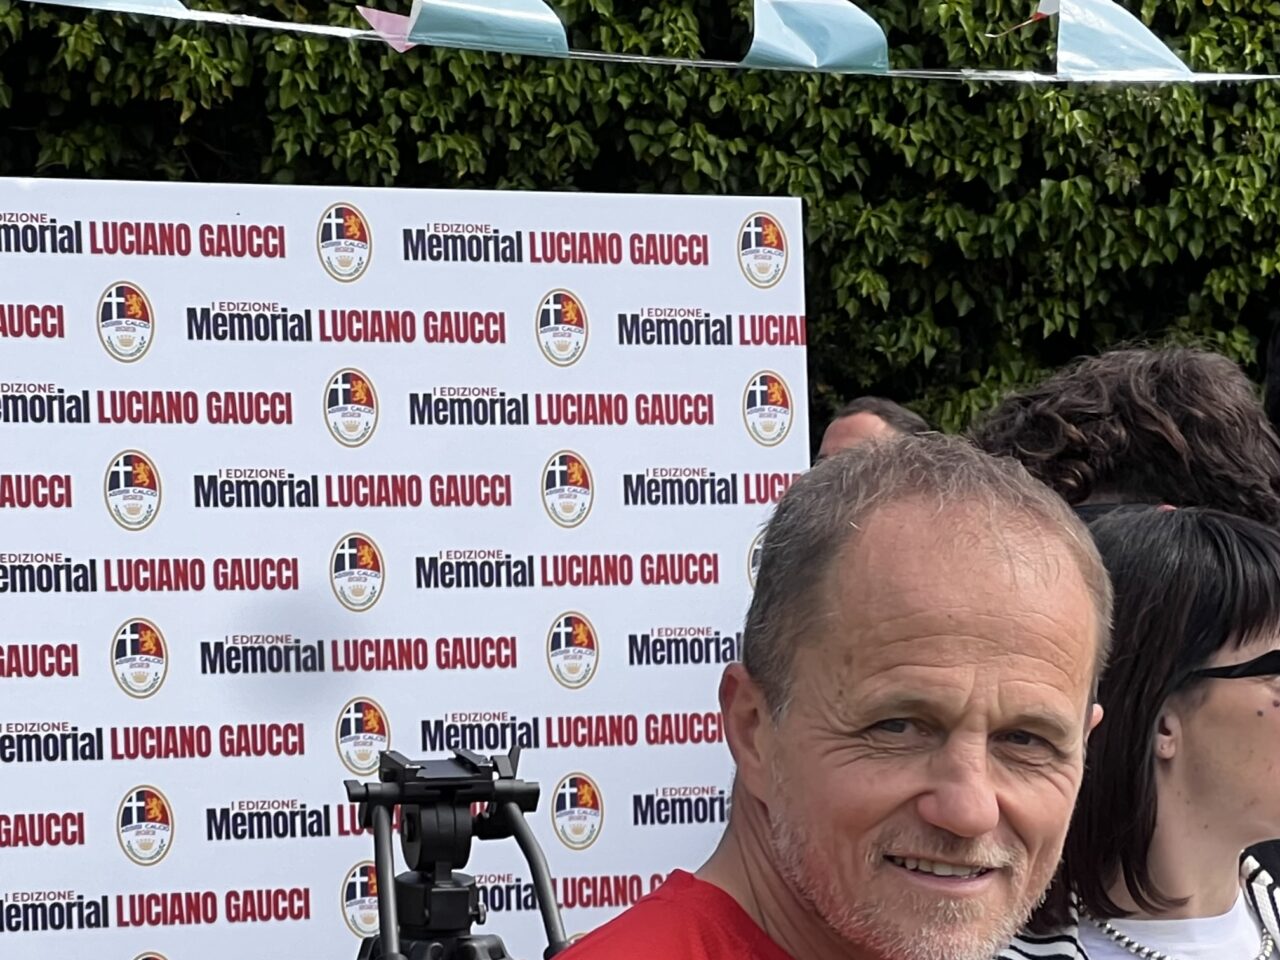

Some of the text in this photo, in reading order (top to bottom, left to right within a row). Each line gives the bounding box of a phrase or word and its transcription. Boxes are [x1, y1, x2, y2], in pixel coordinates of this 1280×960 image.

[0, 213, 47, 223] IZIONE
[434, 223, 491, 234] EDIZIONE
[0, 218, 286, 258] morial LUCIANO GAUCCI
[403, 228, 710, 265] Memorial LUCIANO GAUCCI
[0, 304, 64, 337] AUCCI
[219, 302, 279, 313] EDIZIONE
[648, 308, 702, 318] EDIZIONE
[187, 307, 506, 344] Memorial LUCIANO GAUCCI
[618, 313, 807, 346] Memorial LUCIA
[0, 383, 55, 393] DIZIONE
[440, 387, 498, 397] EDIZIONE
[0, 388, 293, 424] morial LUCIANO GAUCCI
[410, 393, 715, 426] Memorial LUCIANO GAUCCI
[226, 468, 285, 478] EDIZIONE
[653, 467, 708, 477] EDIZIONE
[0, 475, 73, 508] AUCCI
[194, 474, 513, 508] Memorial LUCIANO GAUCCI
[623, 472, 800, 506] Memorial LUCI
[416, 553, 719, 589] Memorial LUCIANO GAUCCI
[446, 550, 503, 560] EDIZIONE
[0, 557, 300, 593] emorial LUCIANO GAUCCI
[233, 634, 292, 645] EDIZIONE
[658, 626, 713, 637] EDIZIONE
[200, 636, 518, 675] Memorial LUCIANO GAUCCI
[6, 721, 69, 733] EDIZIONE
[421, 711, 724, 752] Memorial LUCIANO GAUCCI
[452, 711, 508, 722] EDIZIONE
[0, 723, 306, 763] emorial LUCIANO GAUCCI
[239, 799, 298, 810] EDIZIONE
[662, 786, 717, 796] EDIZIONE
[206, 803, 331, 841] Memorial
[632, 790, 732, 826] Memori
[0, 812, 85, 848] GAUCCI
[12, 890, 75, 902] EDIZIONE
[117, 892, 219, 928] LUCIANO
[225, 888, 311, 923] GAUCCI
